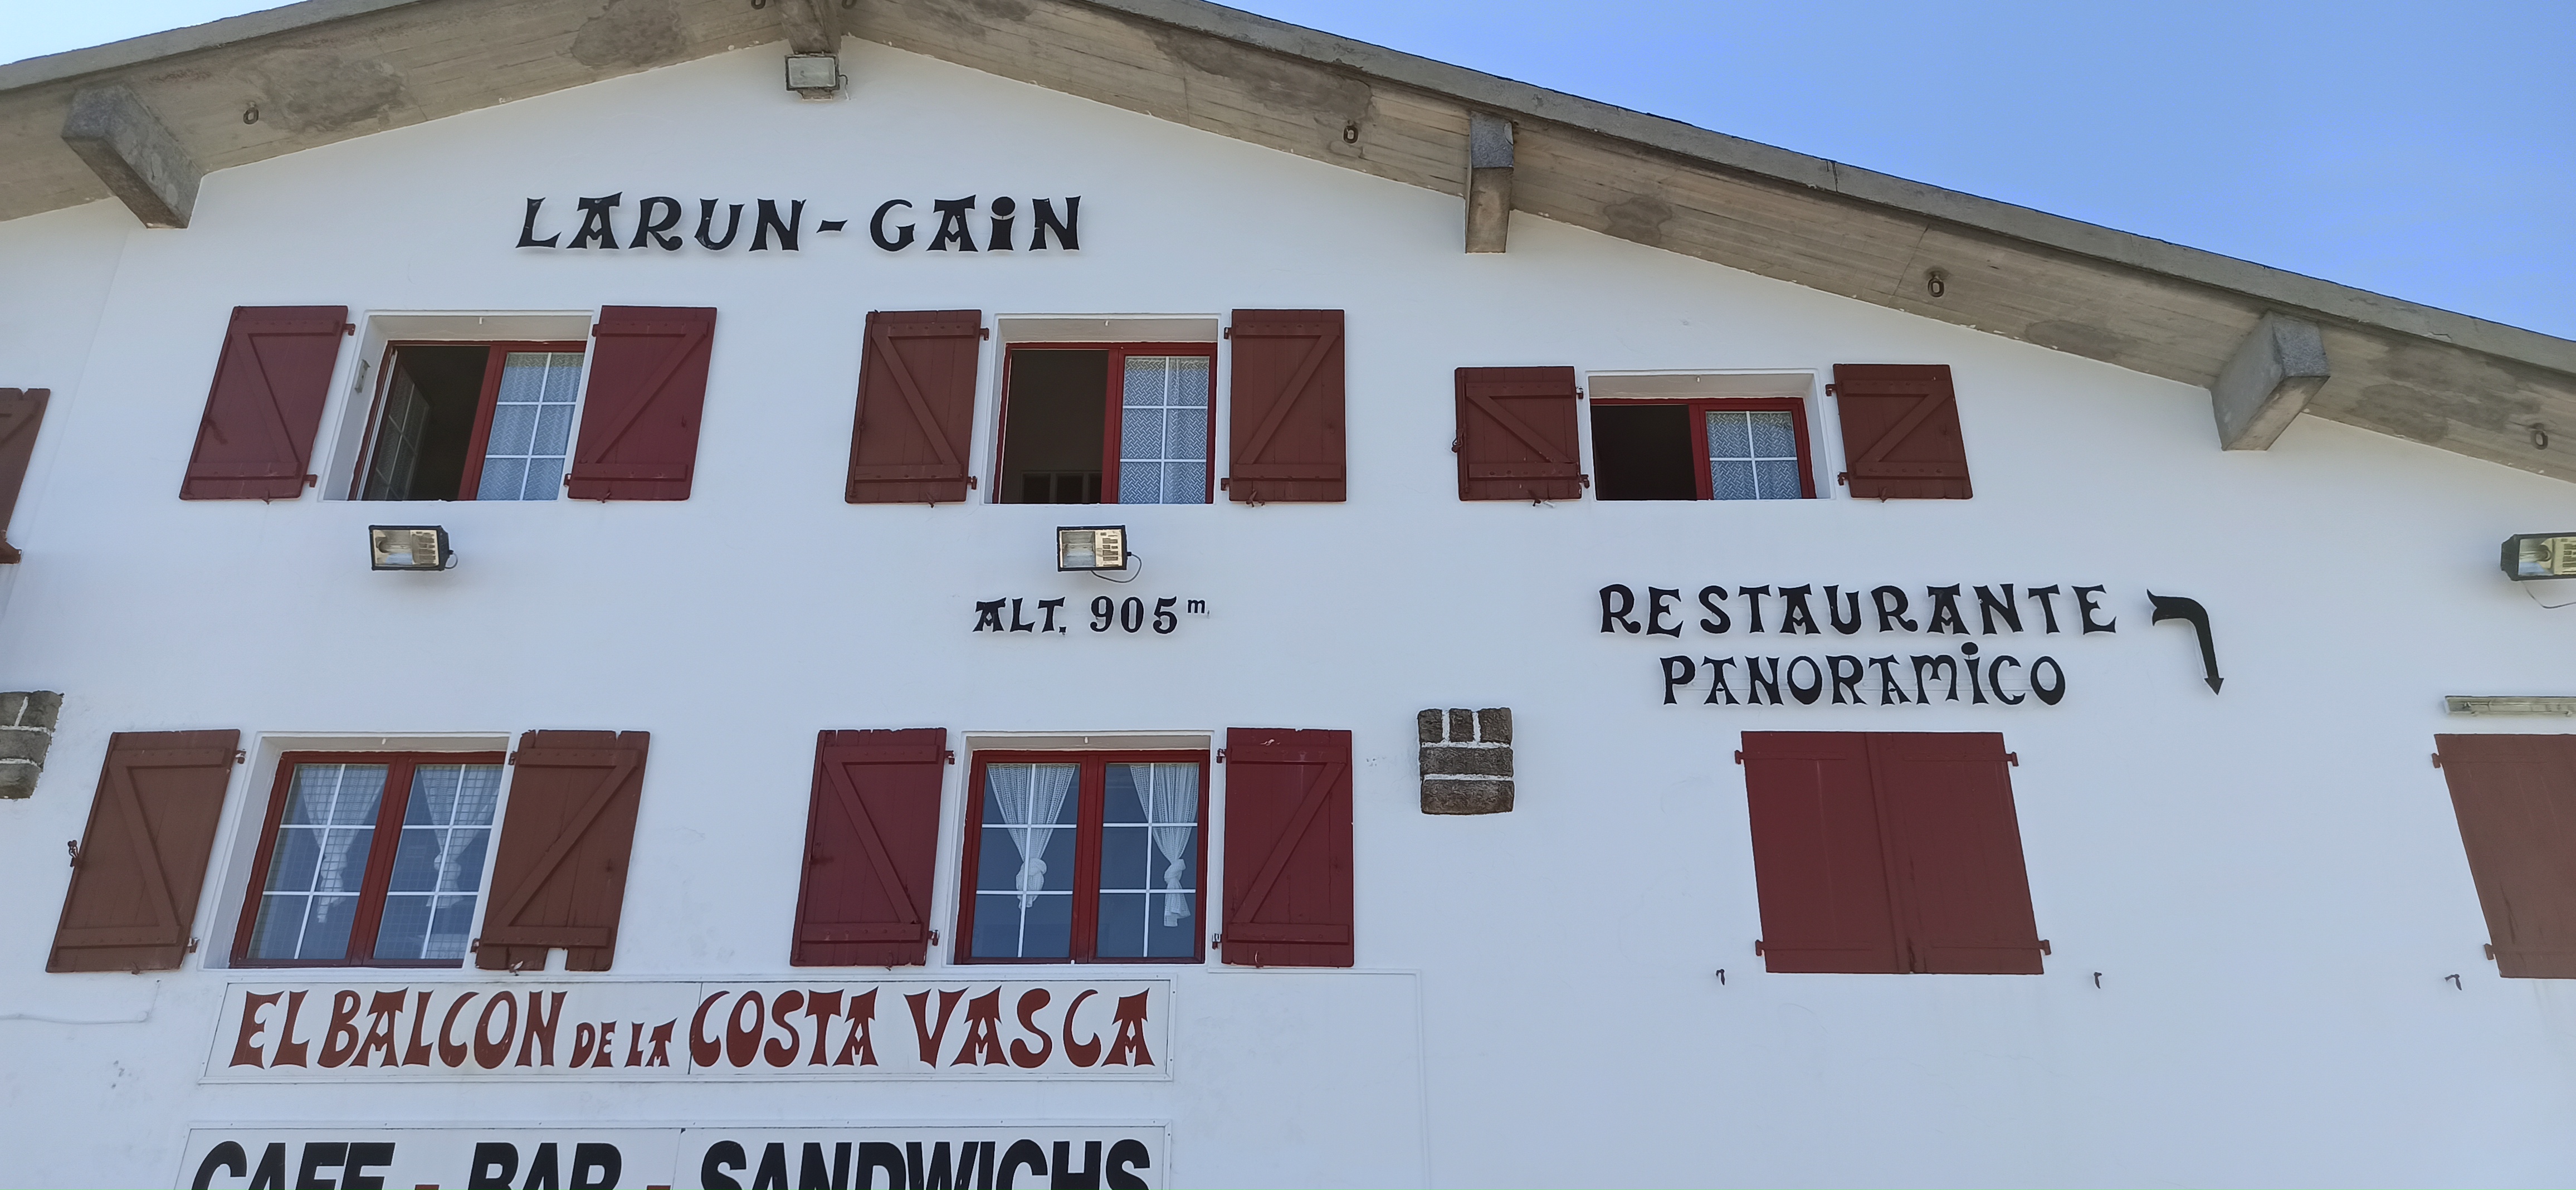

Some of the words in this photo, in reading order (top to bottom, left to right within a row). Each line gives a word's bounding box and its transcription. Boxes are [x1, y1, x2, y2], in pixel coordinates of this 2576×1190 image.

[972, 597, 1066, 633] ALT.
[1599, 583, 2116, 638] RESTAURANTE
[230, 992, 309, 1068] EL
[318, 988, 567, 1069] BALCON
[570, 1023, 616, 1069] DE
[626, 1021, 675, 1067] LA
[690, 988, 878, 1068] COSTA
[905, 988, 1153, 1069] VASCA
